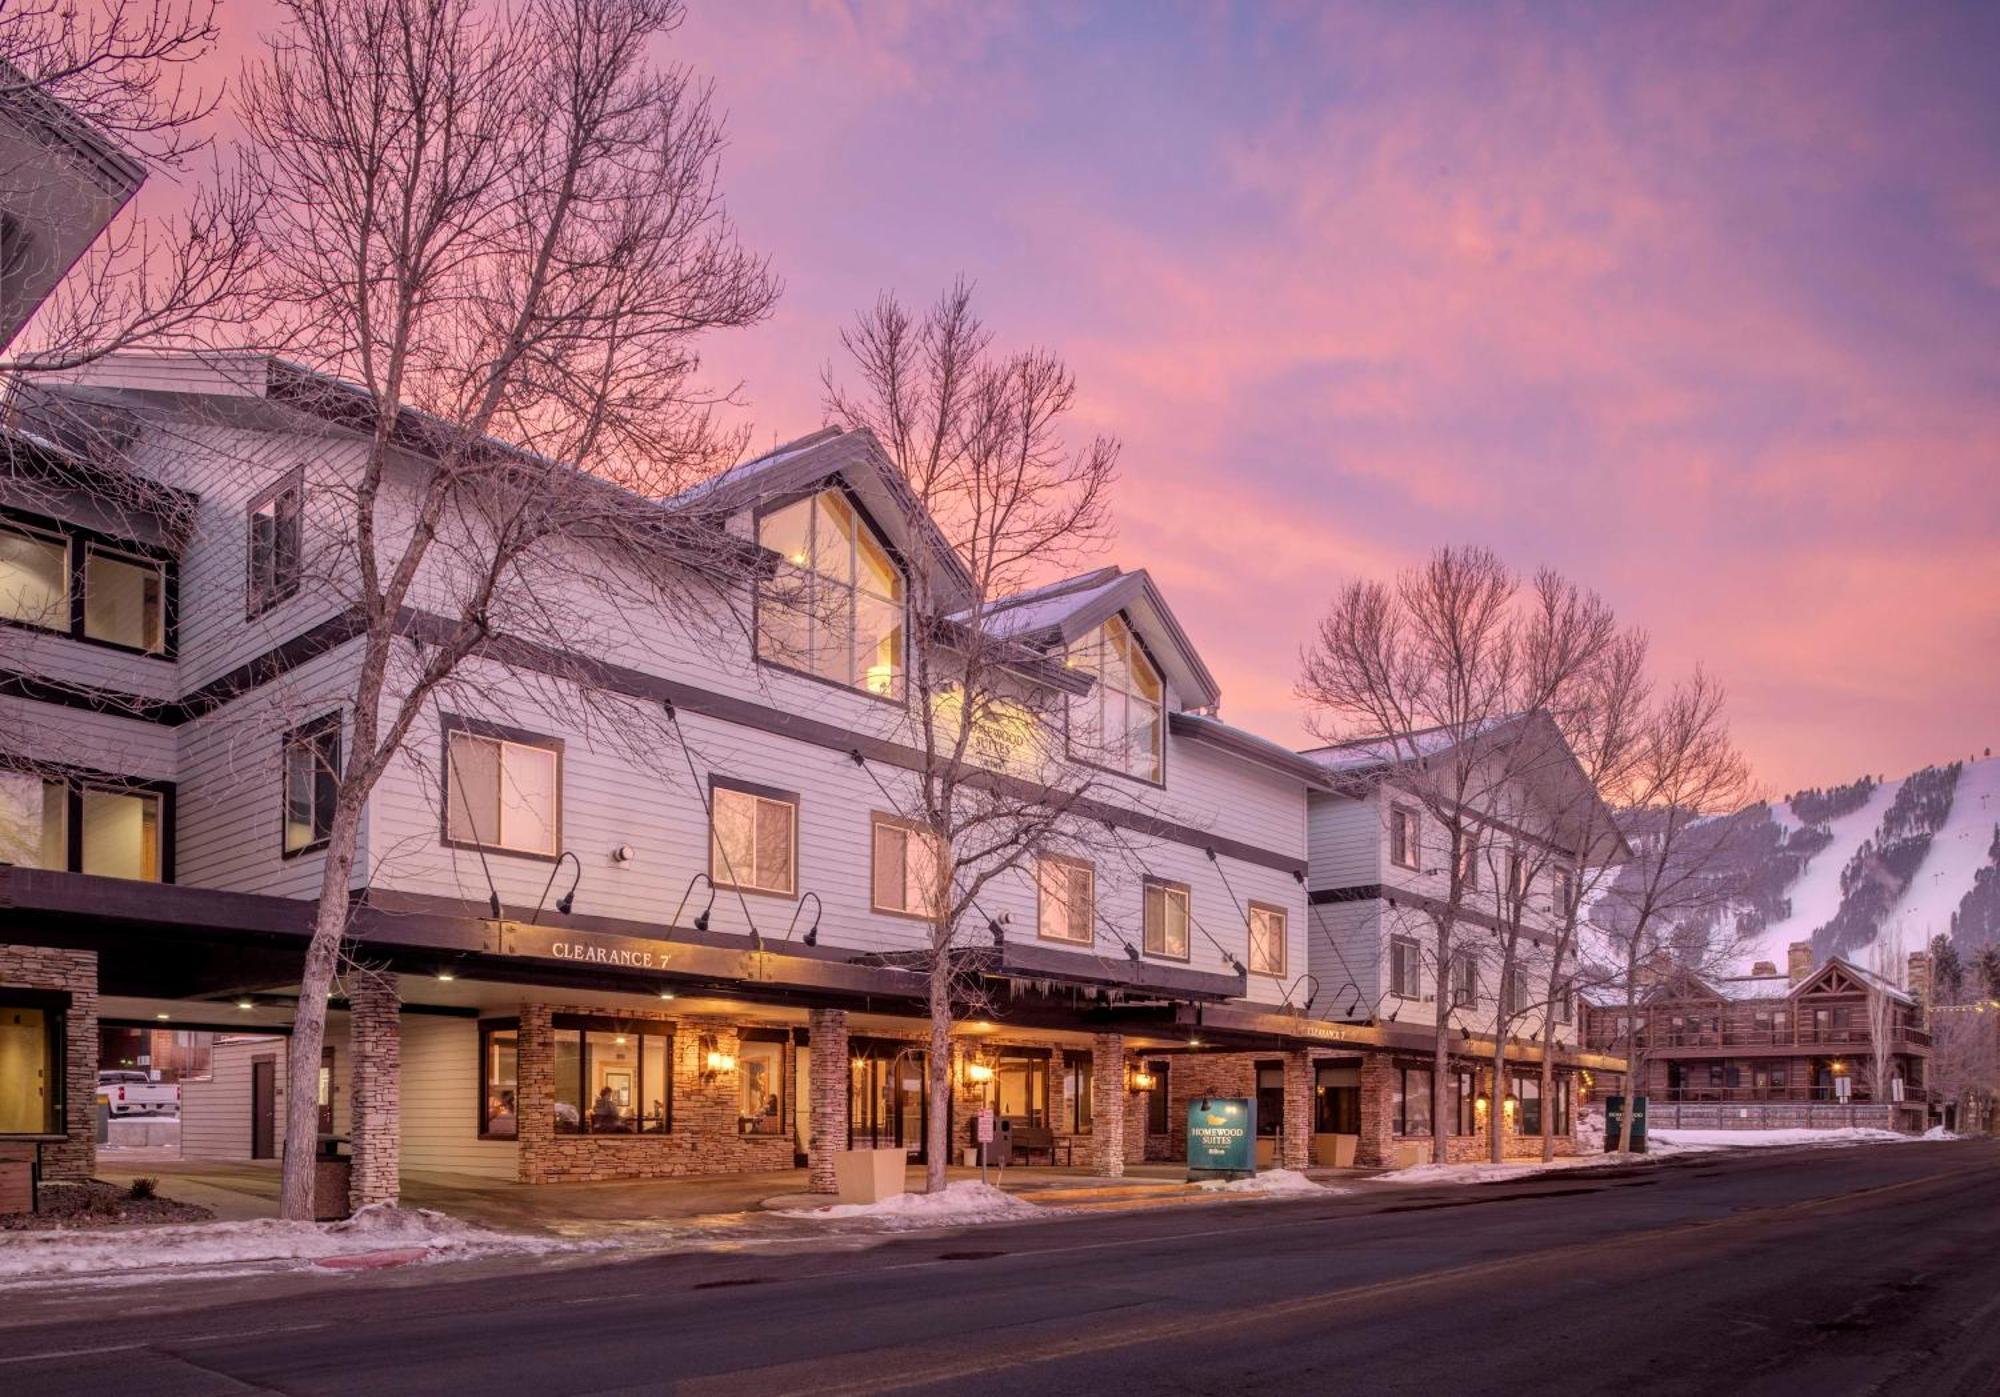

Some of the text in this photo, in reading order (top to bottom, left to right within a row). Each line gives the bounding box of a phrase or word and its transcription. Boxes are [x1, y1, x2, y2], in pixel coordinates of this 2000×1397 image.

[552, 943, 652, 967] CLEARANCE
[1191, 1127, 1244, 1137] HOMEWOOD
[1200, 1136, 1232, 1145] SUITES
